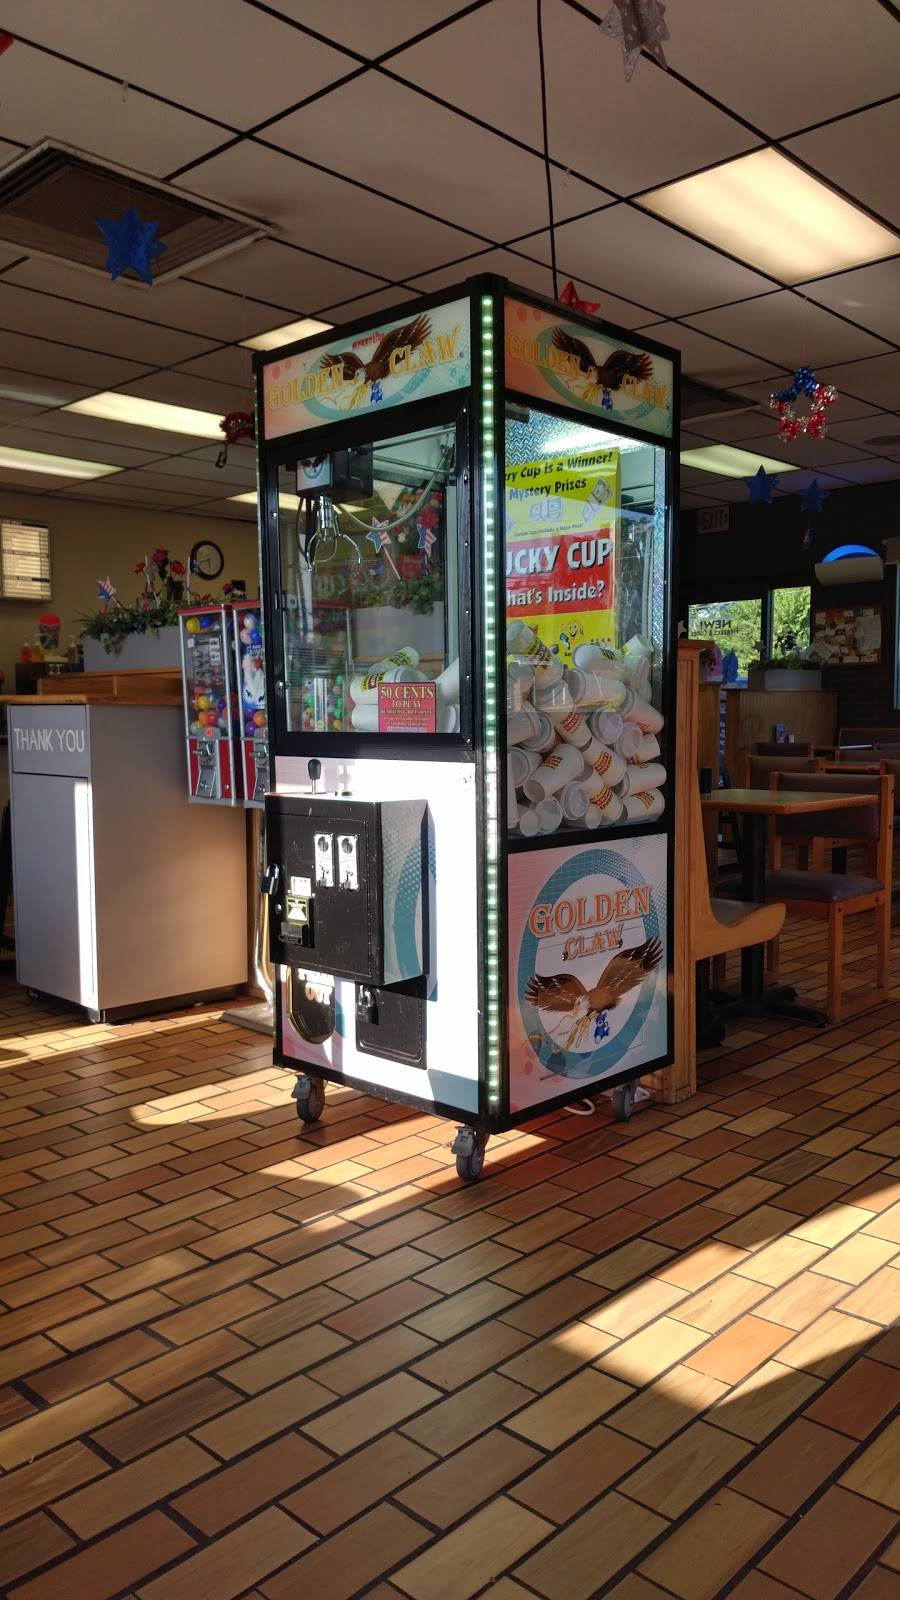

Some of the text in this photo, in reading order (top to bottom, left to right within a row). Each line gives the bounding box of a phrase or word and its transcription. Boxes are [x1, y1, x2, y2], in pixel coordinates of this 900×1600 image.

[388, 323, 461, 377] CLAW
[508, 335, 583, 376] GOLDEN
[268, 362, 345, 411] GOLDEN
[622, 373, 667, 410] CLAW
[520, 466, 541, 479] Cup
[544, 463, 554, 473] is
[557, 462, 564, 472] a
[567, 452, 613, 470] Winner!
[509, 478, 587, 501] Mystery Prizes
[566, 538, 614, 570] CUP
[548, 580, 606, 604] Inside?
[381, 686, 434, 699] 50 CENTS
[14, 728, 85, 753] THANK YOU
[529, 885, 653, 939] GOLDEN
[565, 922, 624, 960] CLAW
